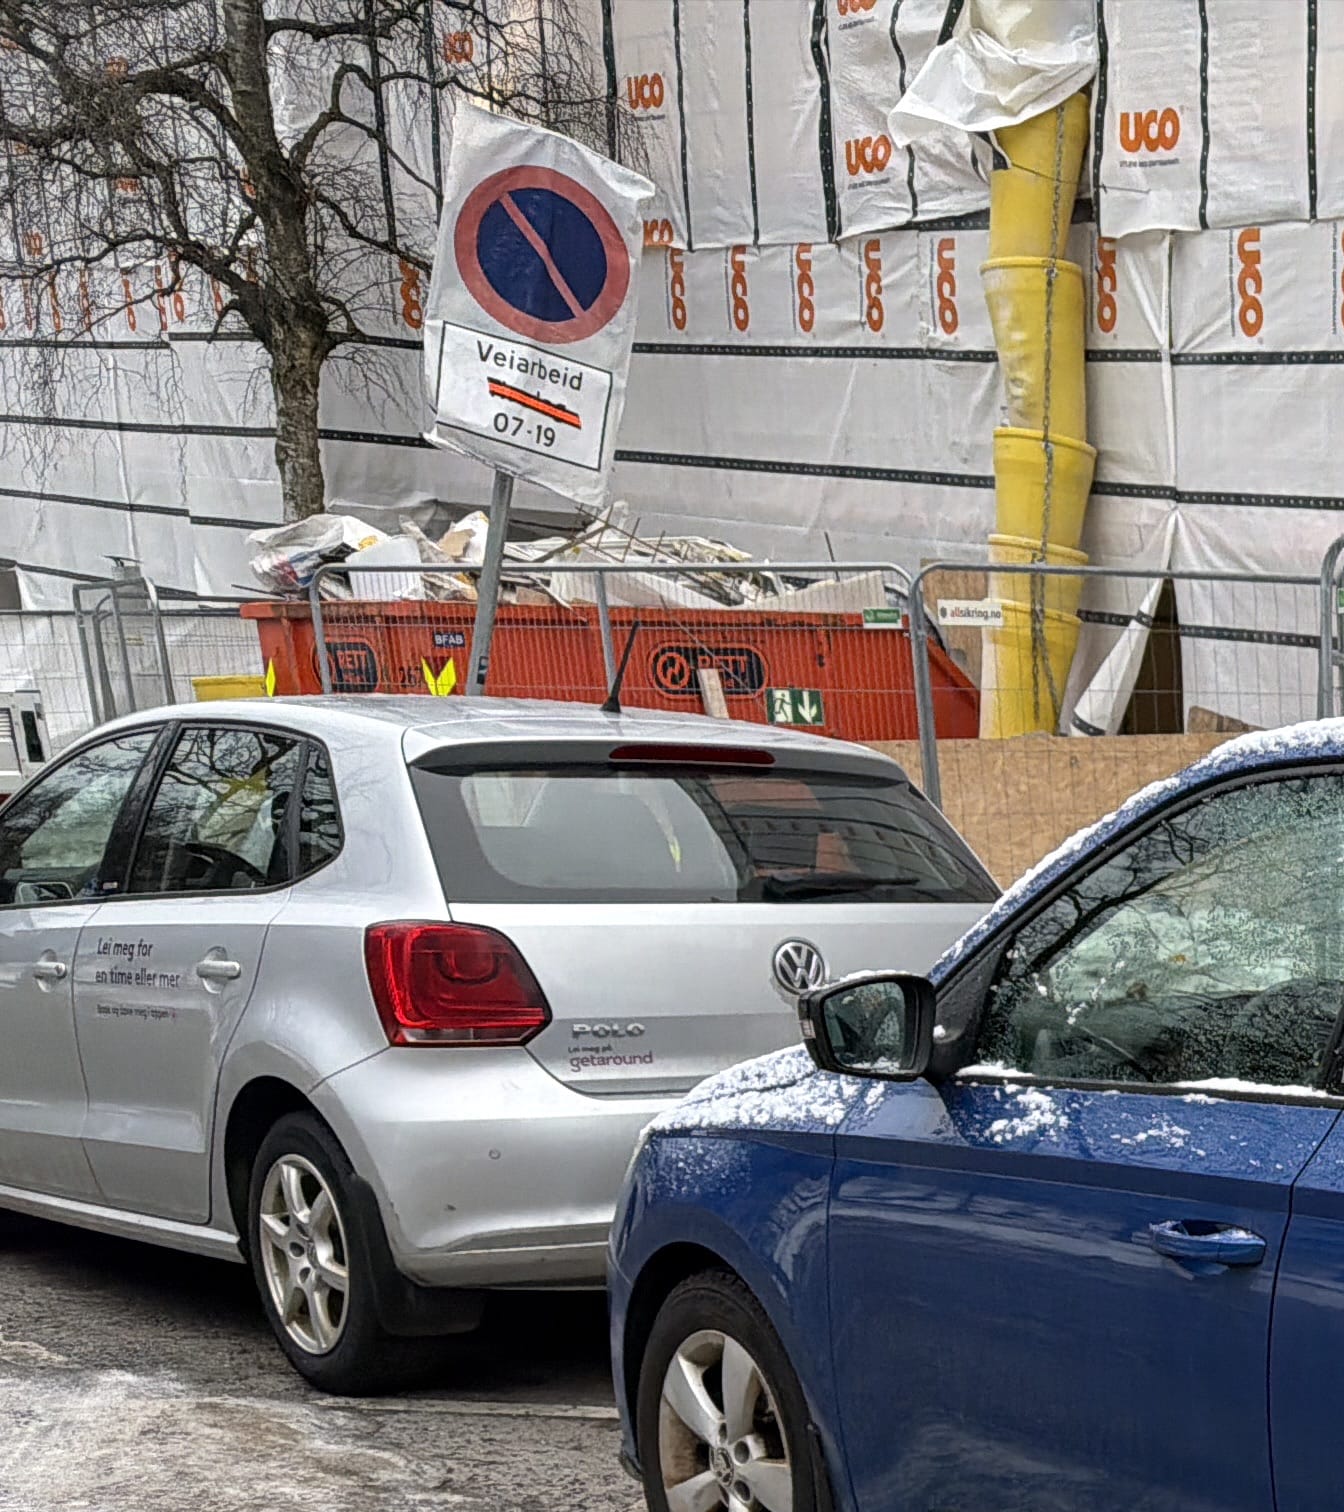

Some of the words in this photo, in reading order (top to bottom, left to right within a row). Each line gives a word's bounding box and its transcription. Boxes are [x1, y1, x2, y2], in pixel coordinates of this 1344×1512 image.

[627, 72, 664, 110] UCO
[1120, 107, 1180, 153] UCO
[845, 134, 892, 176] UCO
[670, 248, 686, 330] UCO
[731, 244, 749, 332] UCO
[796, 242, 814, 332] UCO
[864, 238, 884, 333] UCO
[937, 237, 959, 335] UCO
[1238, 227, 1264, 337] UCO
[477, 340, 583, 391] Veiarbeid
[493, 412, 556, 447] 07-19
[950, 607, 1001, 620] allsikring.no
[434, 633, 464, 645] BFAB
[97, 937, 112, 955] Lei
[113, 942, 135, 961] meg
[137, 938, 153, 957] for
[95, 970, 107, 984] en
[110, 965, 132, 985] time
[135, 968, 156, 986] eller
[159, 974, 180, 988] mer
[572, 1022, 646, 1040] POLO
[570, 1050, 653, 1072] getaround
